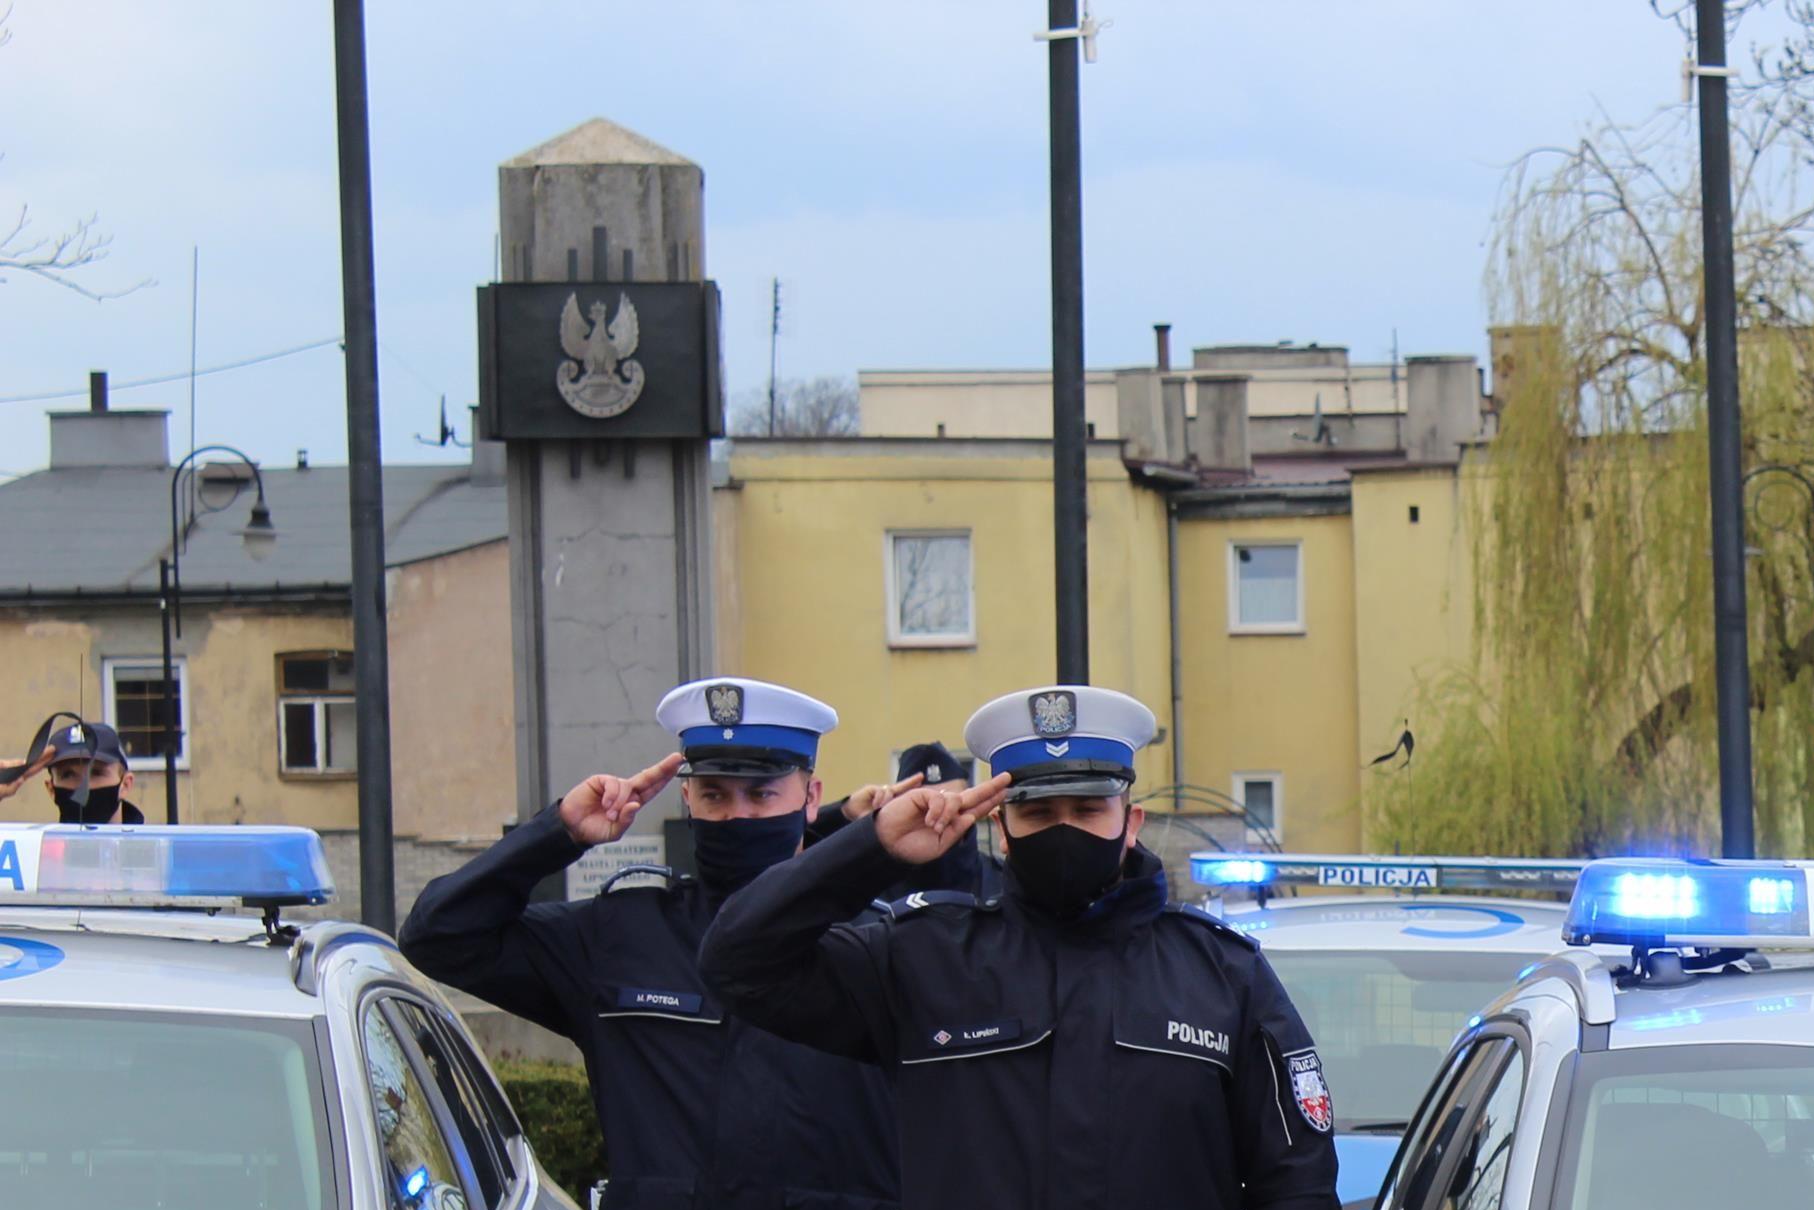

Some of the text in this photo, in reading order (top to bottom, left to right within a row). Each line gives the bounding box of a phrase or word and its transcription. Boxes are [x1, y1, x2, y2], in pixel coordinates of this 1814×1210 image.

[1323, 867, 1431, 886] POLICJA
[1167, 1021, 1229, 1055] POLICJA
[1291, 1056, 1318, 1073] POLICJA
